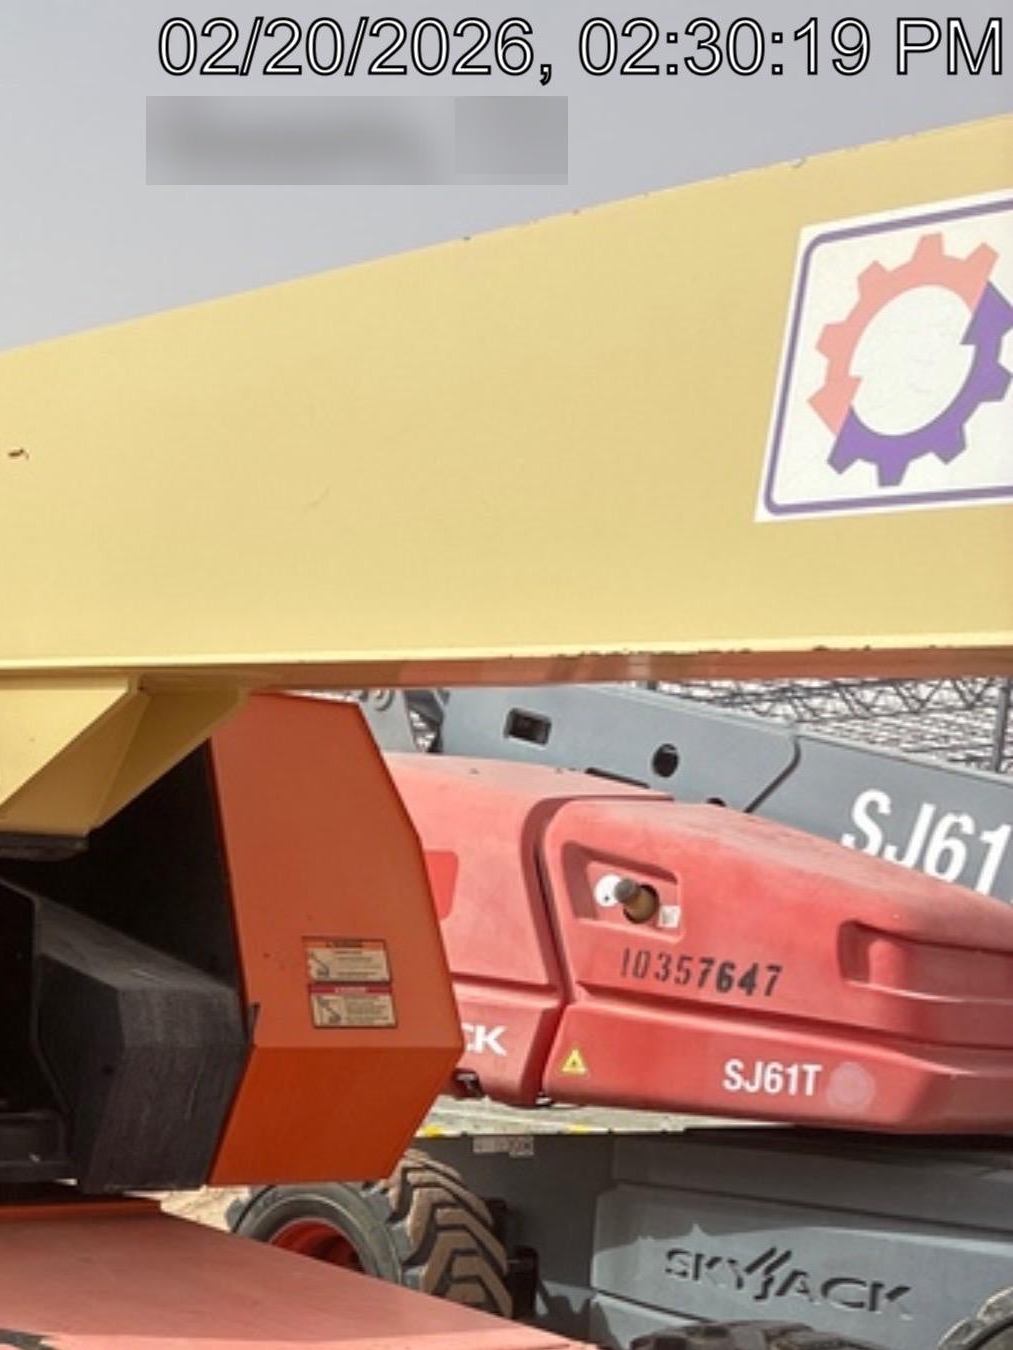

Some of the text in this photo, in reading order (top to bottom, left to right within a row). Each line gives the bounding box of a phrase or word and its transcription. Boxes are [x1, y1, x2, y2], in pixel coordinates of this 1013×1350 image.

[841, 788, 1012, 895] SJ61
[620, 946, 783, 997] 10357647
[722, 1058, 823, 1097] SJ61T
[664, 1245, 915, 1321] SKYJACK
